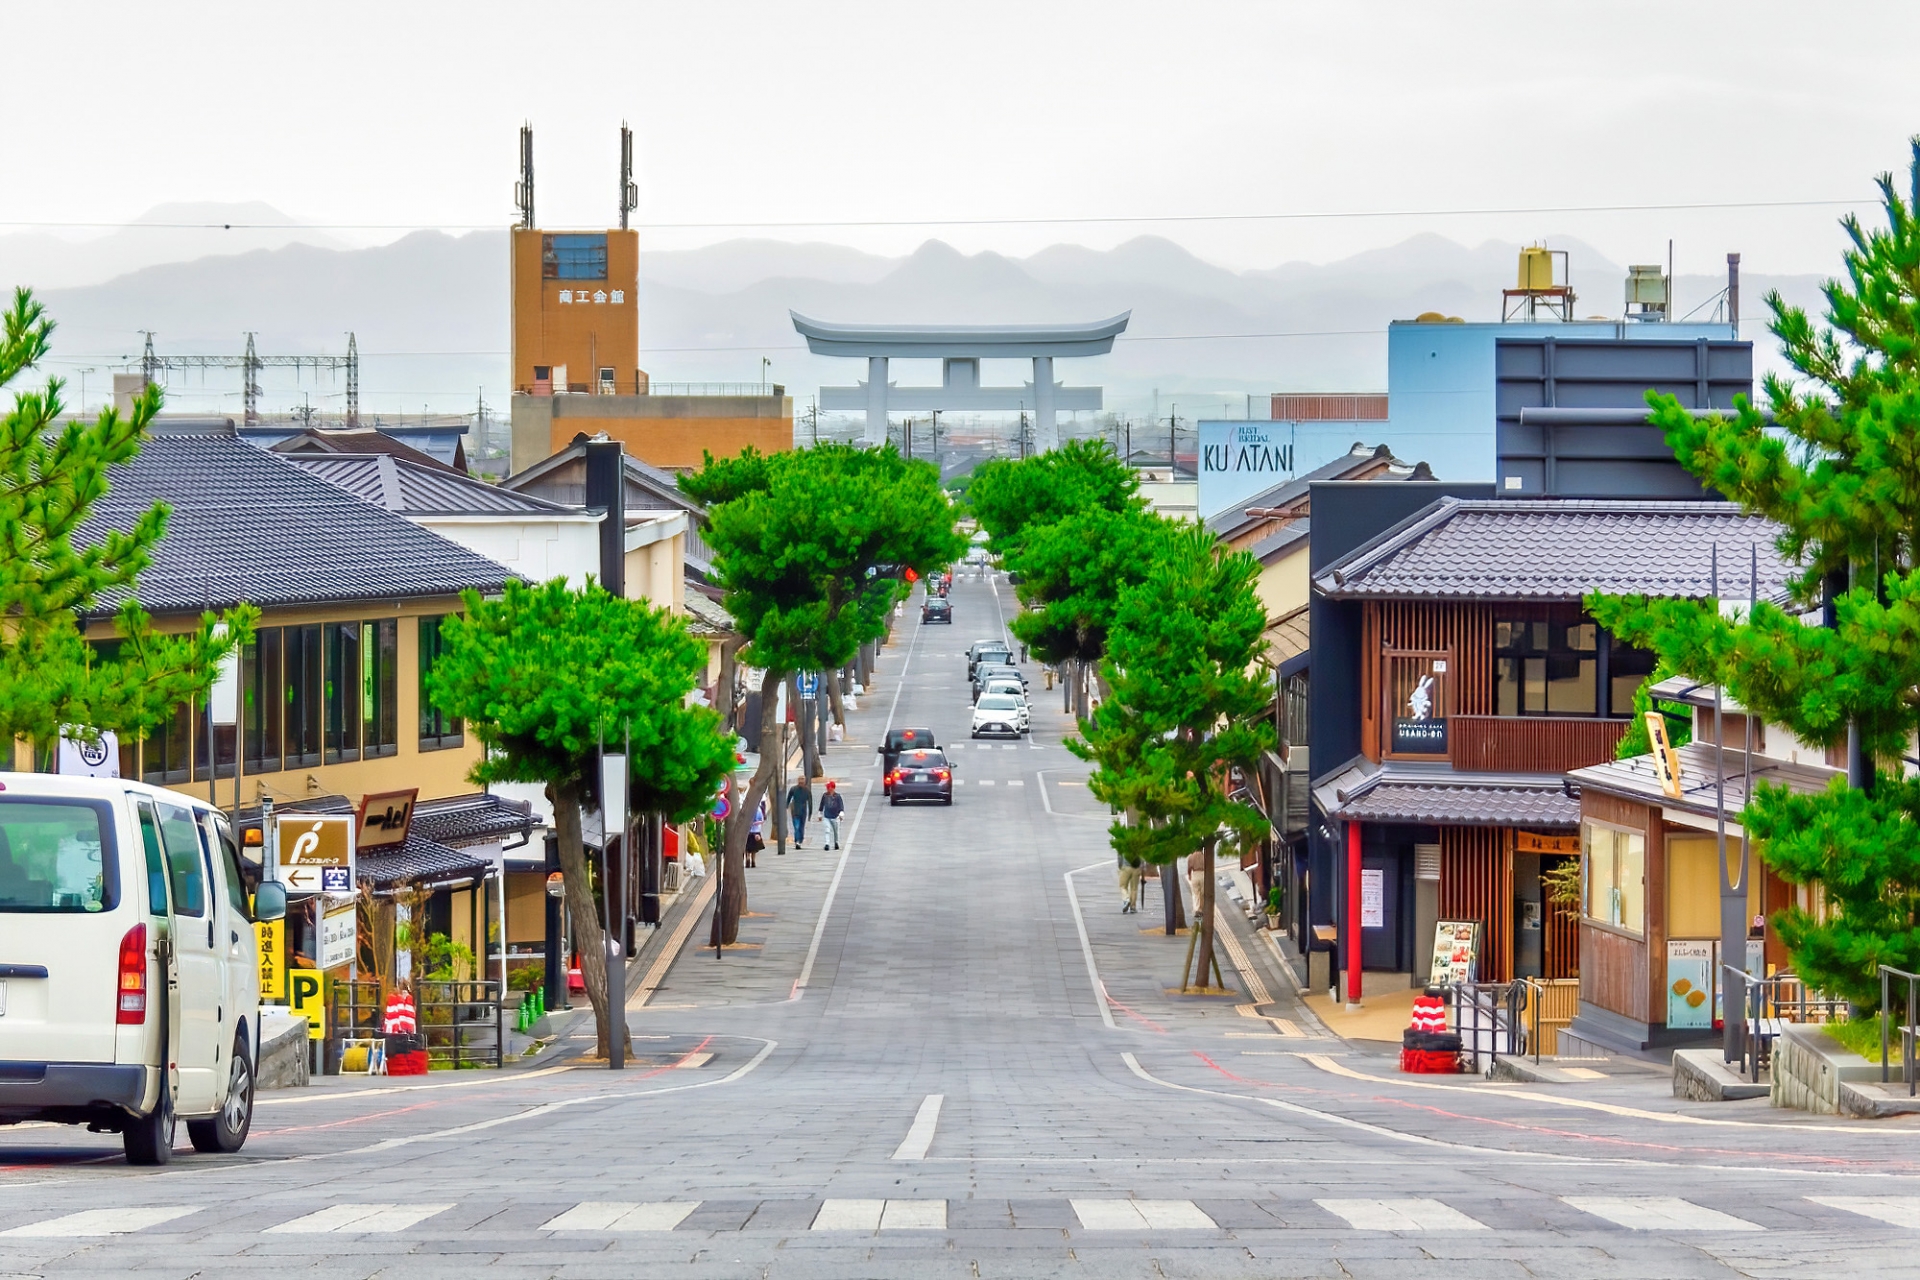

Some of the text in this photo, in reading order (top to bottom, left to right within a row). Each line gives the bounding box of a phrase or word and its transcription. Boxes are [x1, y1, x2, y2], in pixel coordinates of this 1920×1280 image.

[559, 289, 625, 304] 商工会館
[325, 867, 349, 890] 空
[293, 975, 319, 1010] P
